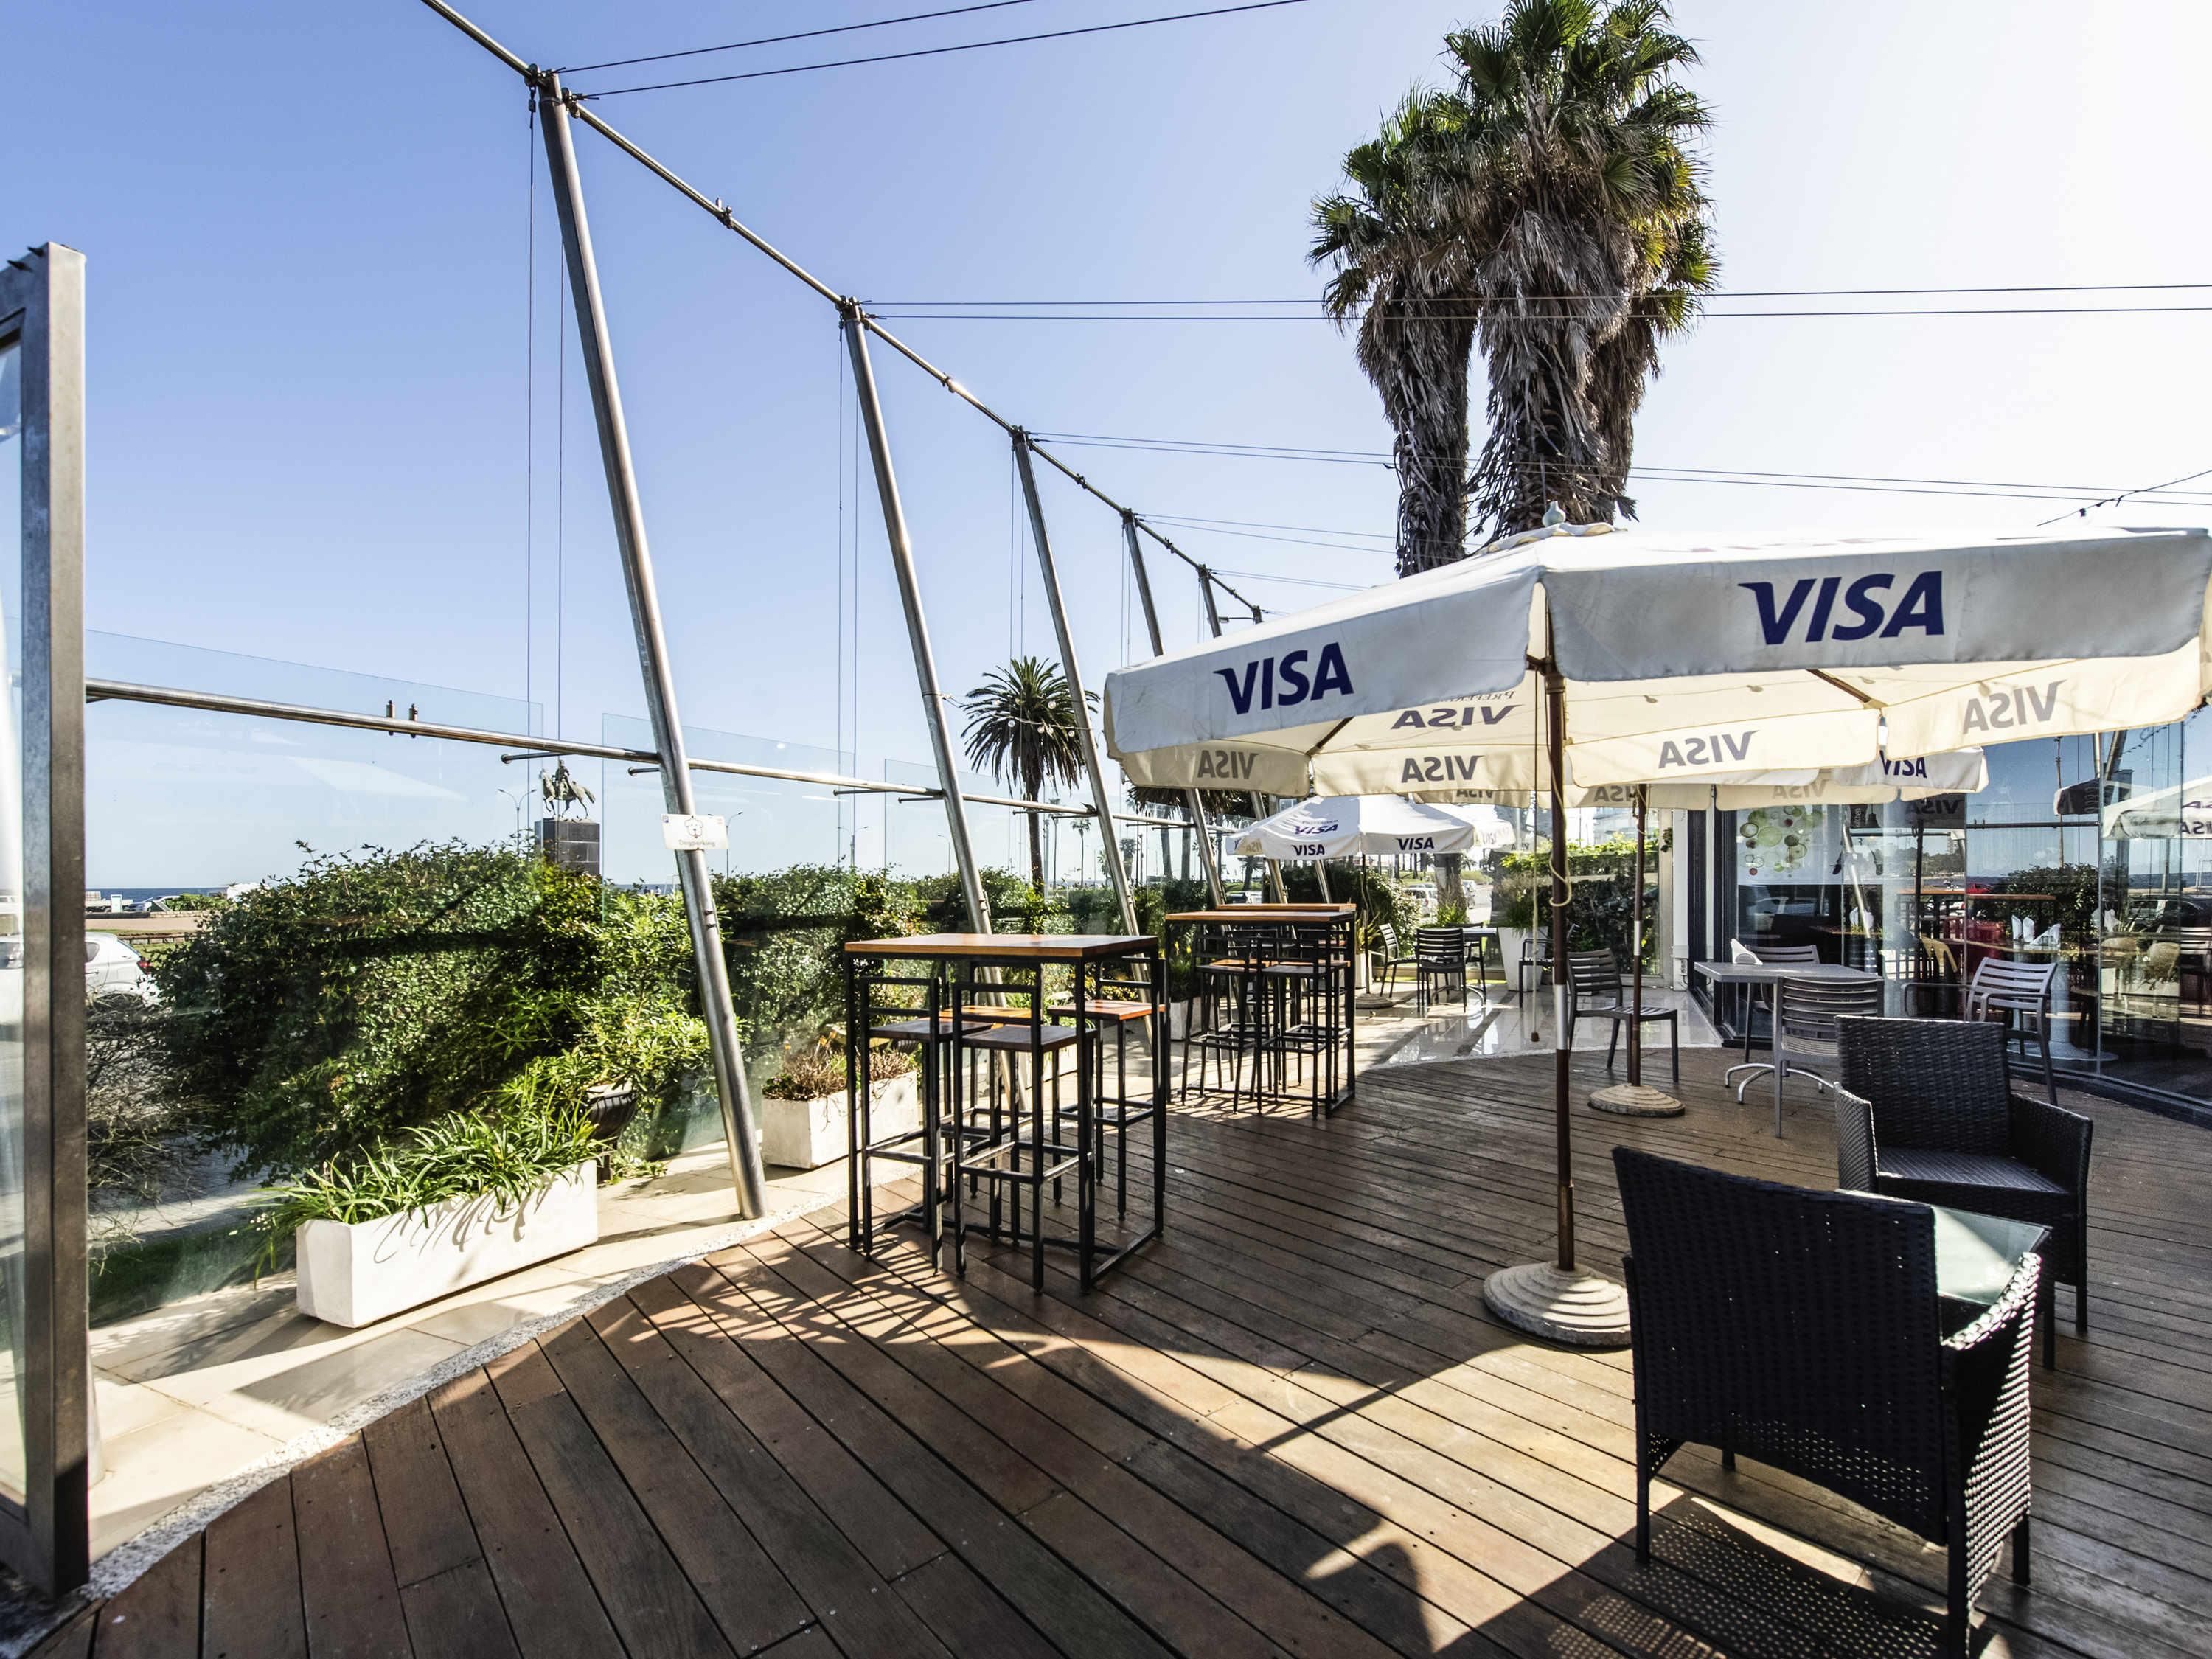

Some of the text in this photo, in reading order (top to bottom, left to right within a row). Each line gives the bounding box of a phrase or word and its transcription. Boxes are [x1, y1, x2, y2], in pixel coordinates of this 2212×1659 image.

[1739, 571, 1945, 646] VISA
[1214, 642, 1354, 714] VISA
[1295, 824, 1338, 834] VISA
[1292, 844, 1325, 855] VISA
[1395, 837, 1435, 850] VISA
